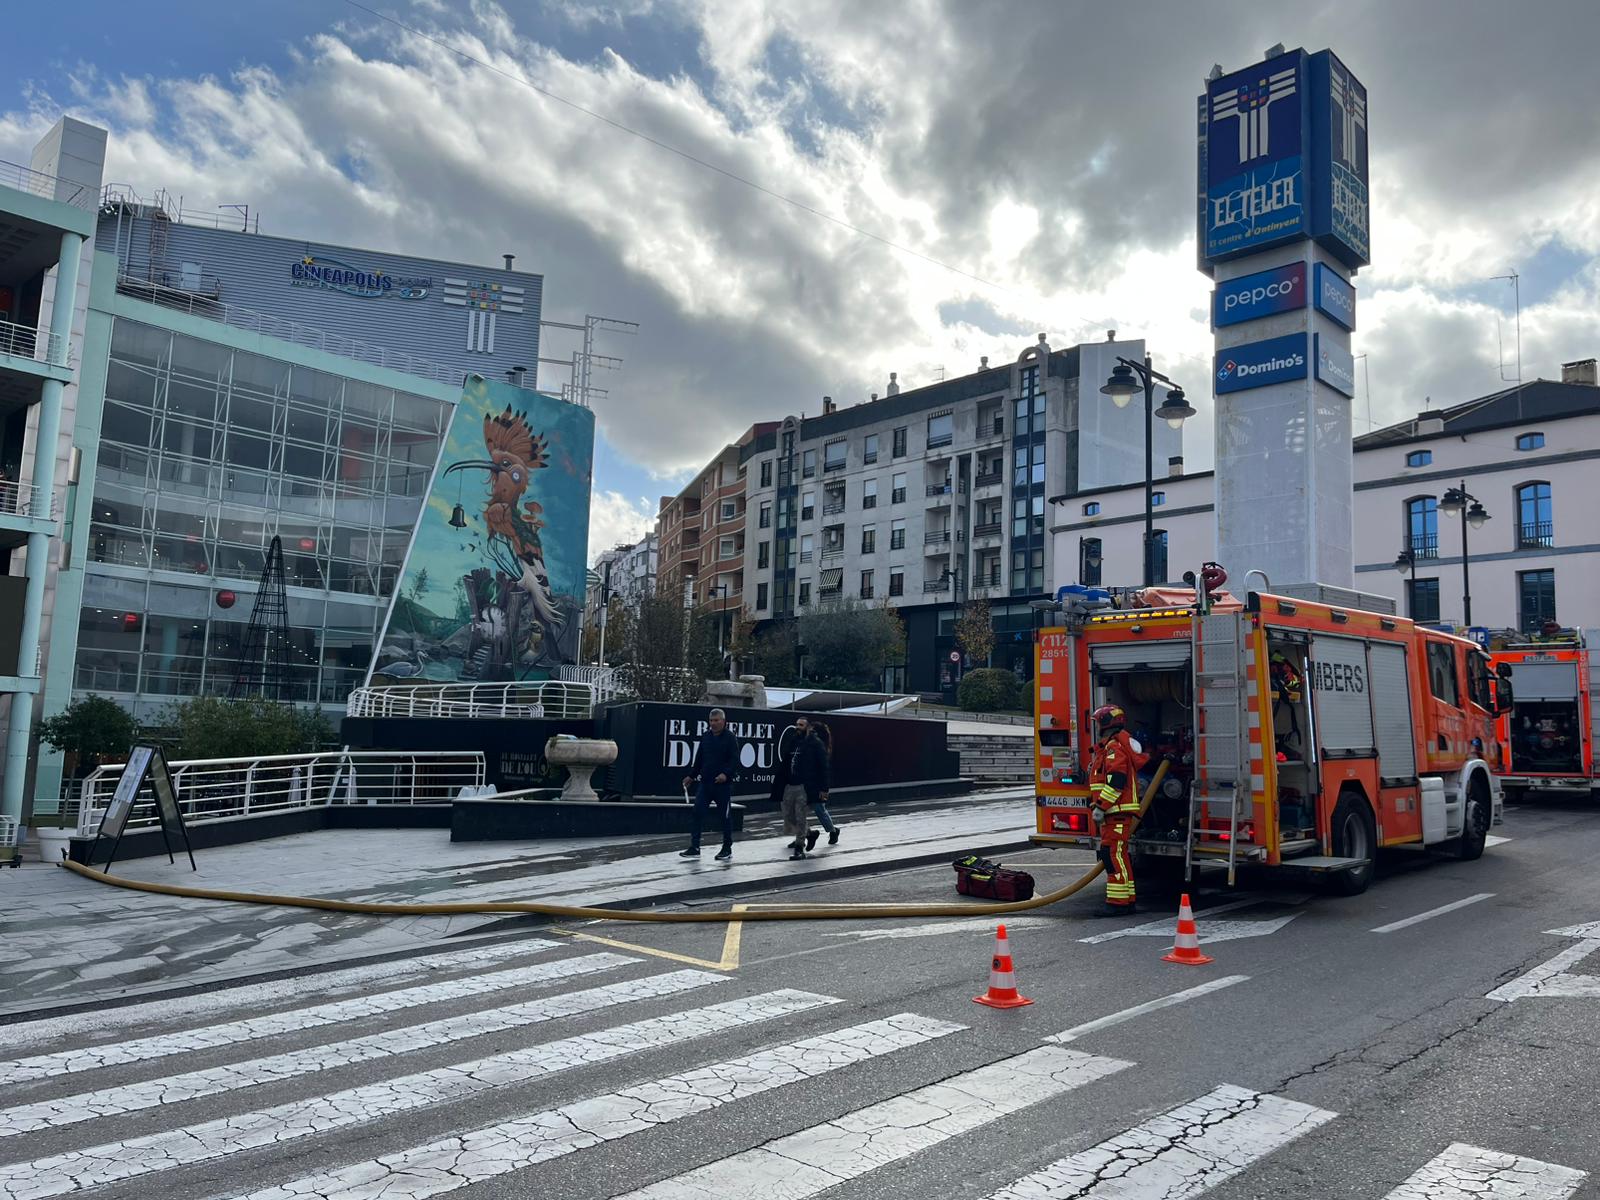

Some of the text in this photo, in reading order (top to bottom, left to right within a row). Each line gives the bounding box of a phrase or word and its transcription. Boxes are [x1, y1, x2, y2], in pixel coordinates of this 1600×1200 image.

[1214, 176, 1295, 228] EL TELER
[291, 262, 392, 290] CINEAPOLIS
[1237, 353, 1304, 377] Domino's
[669, 719, 775, 739] EL RELLET
[667, 740, 701, 767] D
[752, 773, 776, 784] Loung
[1046, 797, 1068, 807] 4446
